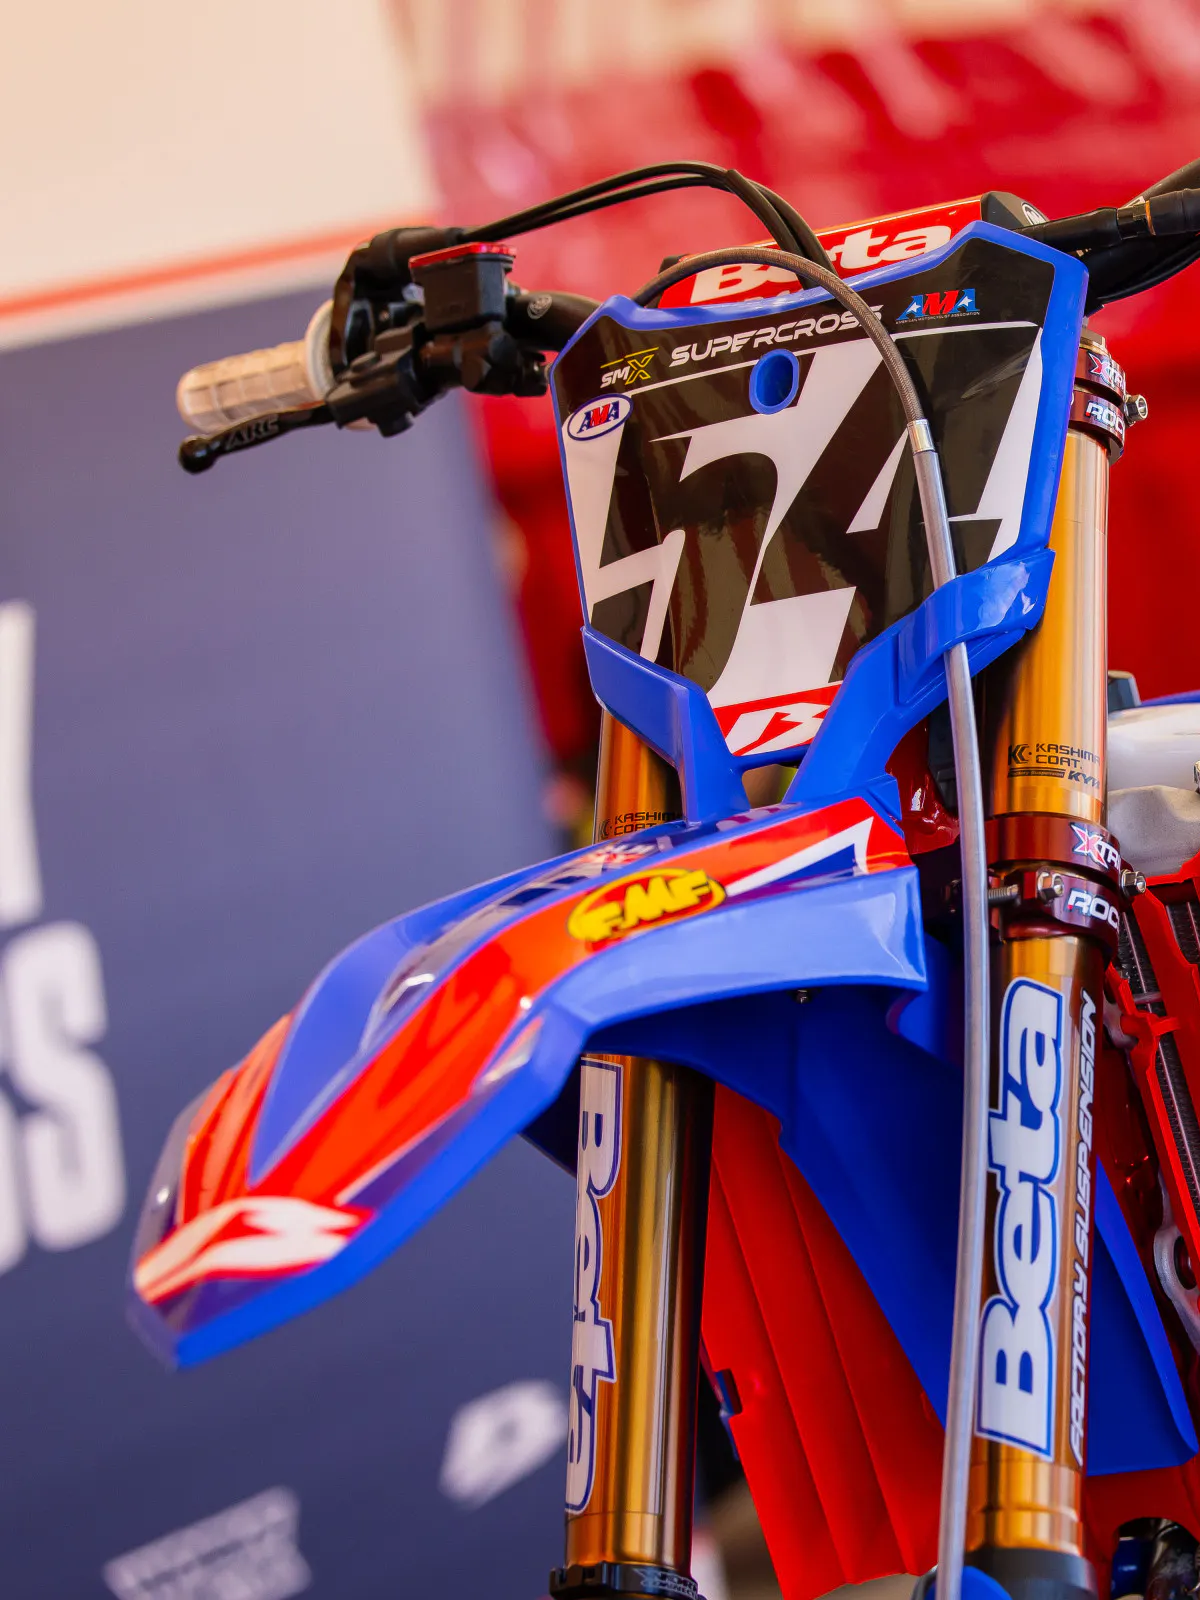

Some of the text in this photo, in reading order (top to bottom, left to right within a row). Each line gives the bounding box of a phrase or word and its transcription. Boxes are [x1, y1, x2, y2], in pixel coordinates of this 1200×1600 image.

[895, 287, 980, 321] AMA
[600, 353, 654, 389] SMX
[576, 400, 621, 434] AMA
[614, 811, 682, 825] KASHIM
[572, 868, 712, 943] FMF
[974, 976, 1065, 1462] Beta
[1068, 988, 1098, 1467] FACTORY SUSPENSION
